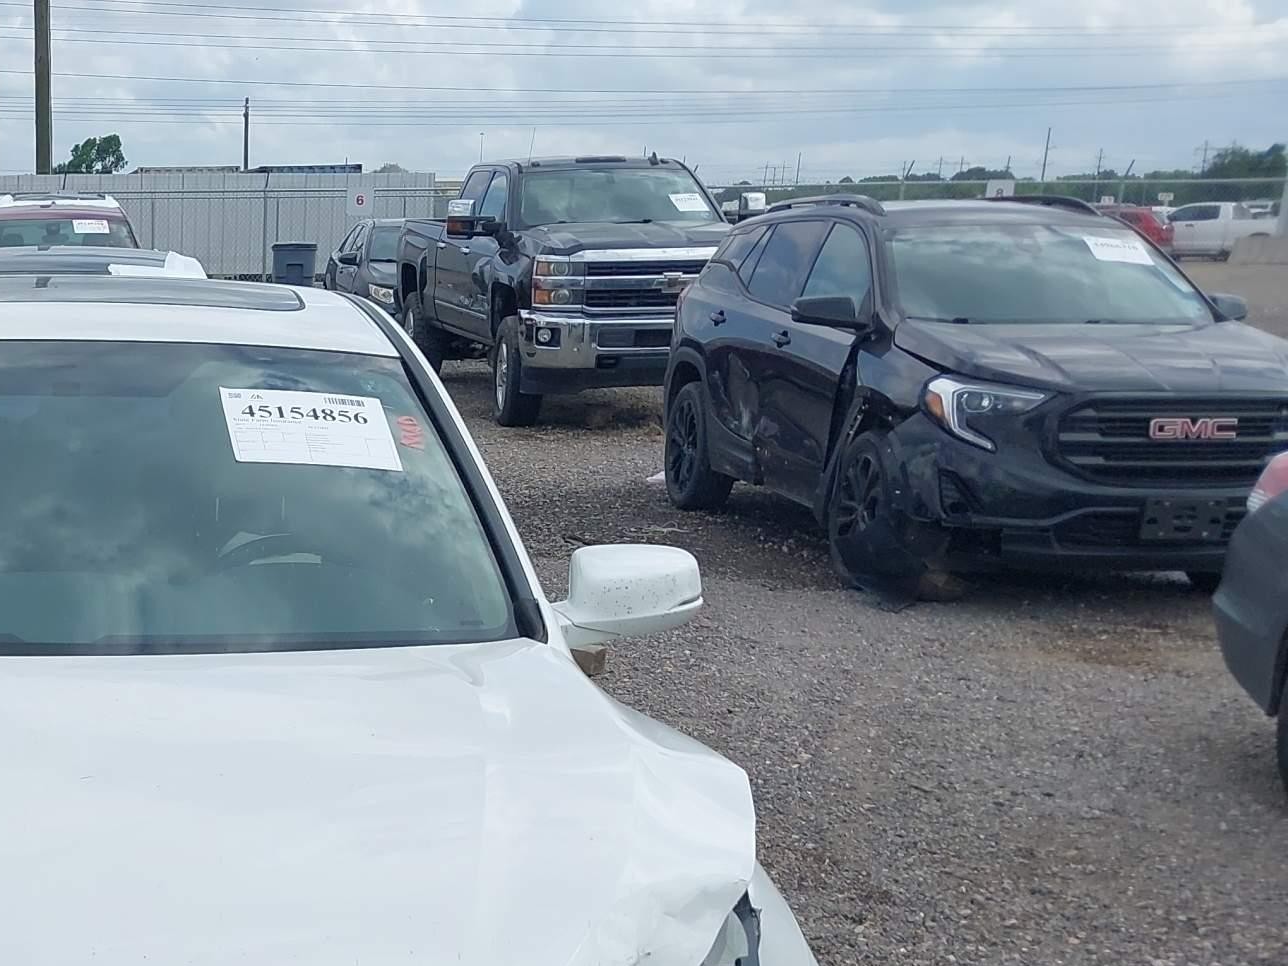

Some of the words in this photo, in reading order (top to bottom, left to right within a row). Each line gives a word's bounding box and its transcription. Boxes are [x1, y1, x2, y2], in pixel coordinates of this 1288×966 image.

[356, 195, 364, 206] 6
[241, 404, 369, 425] 45154856
[1149, 418, 1239, 439] GMC
